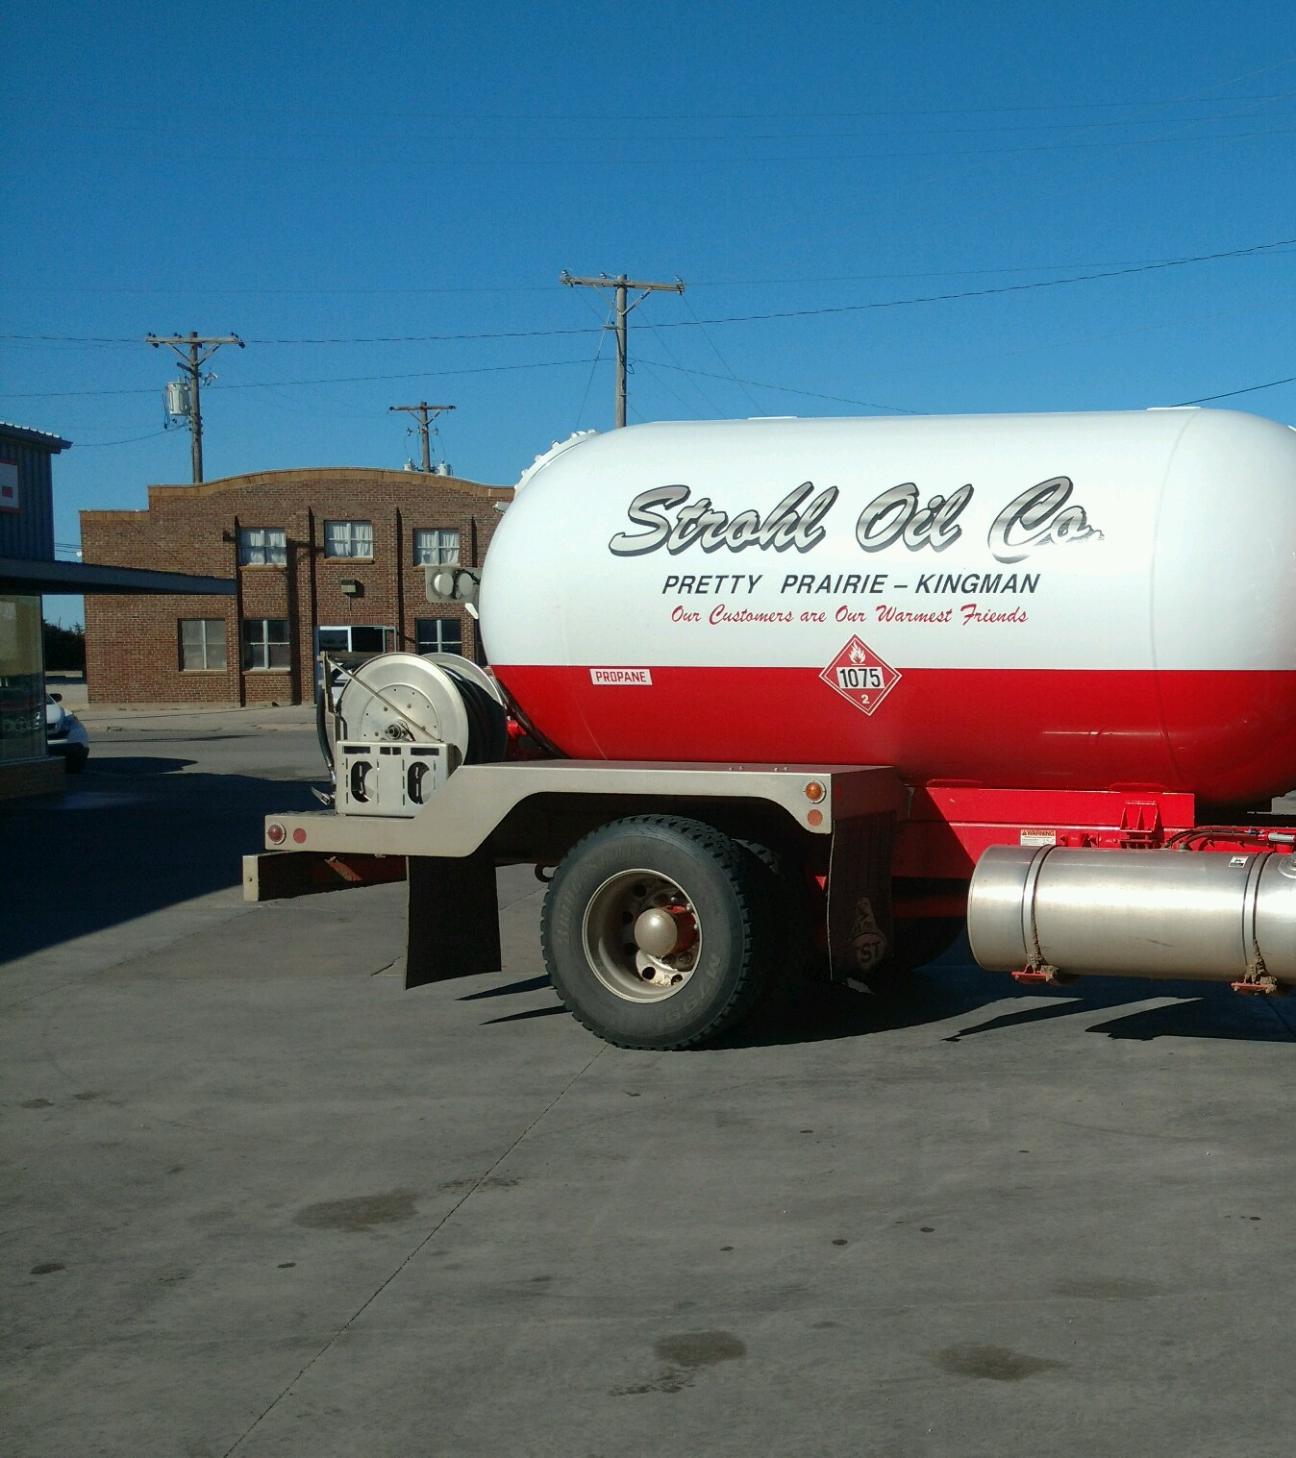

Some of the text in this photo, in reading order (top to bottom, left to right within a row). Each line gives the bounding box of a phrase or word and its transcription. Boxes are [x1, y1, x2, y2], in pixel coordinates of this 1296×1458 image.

[608, 476, 1105, 564] Strohl Oil Co.
[662, 575, 763, 595] PRETTY
[780, 575, 888, 594] PRAIRIE
[915, 574, 1041, 594] KINGMAN
[671, 603, 1028, 625] Our Customers are Our Warmest Friends
[596, 670, 647, 683] PROPANE
[839, 668, 881, 688] 1075
[861, 694, 870, 704] 2
